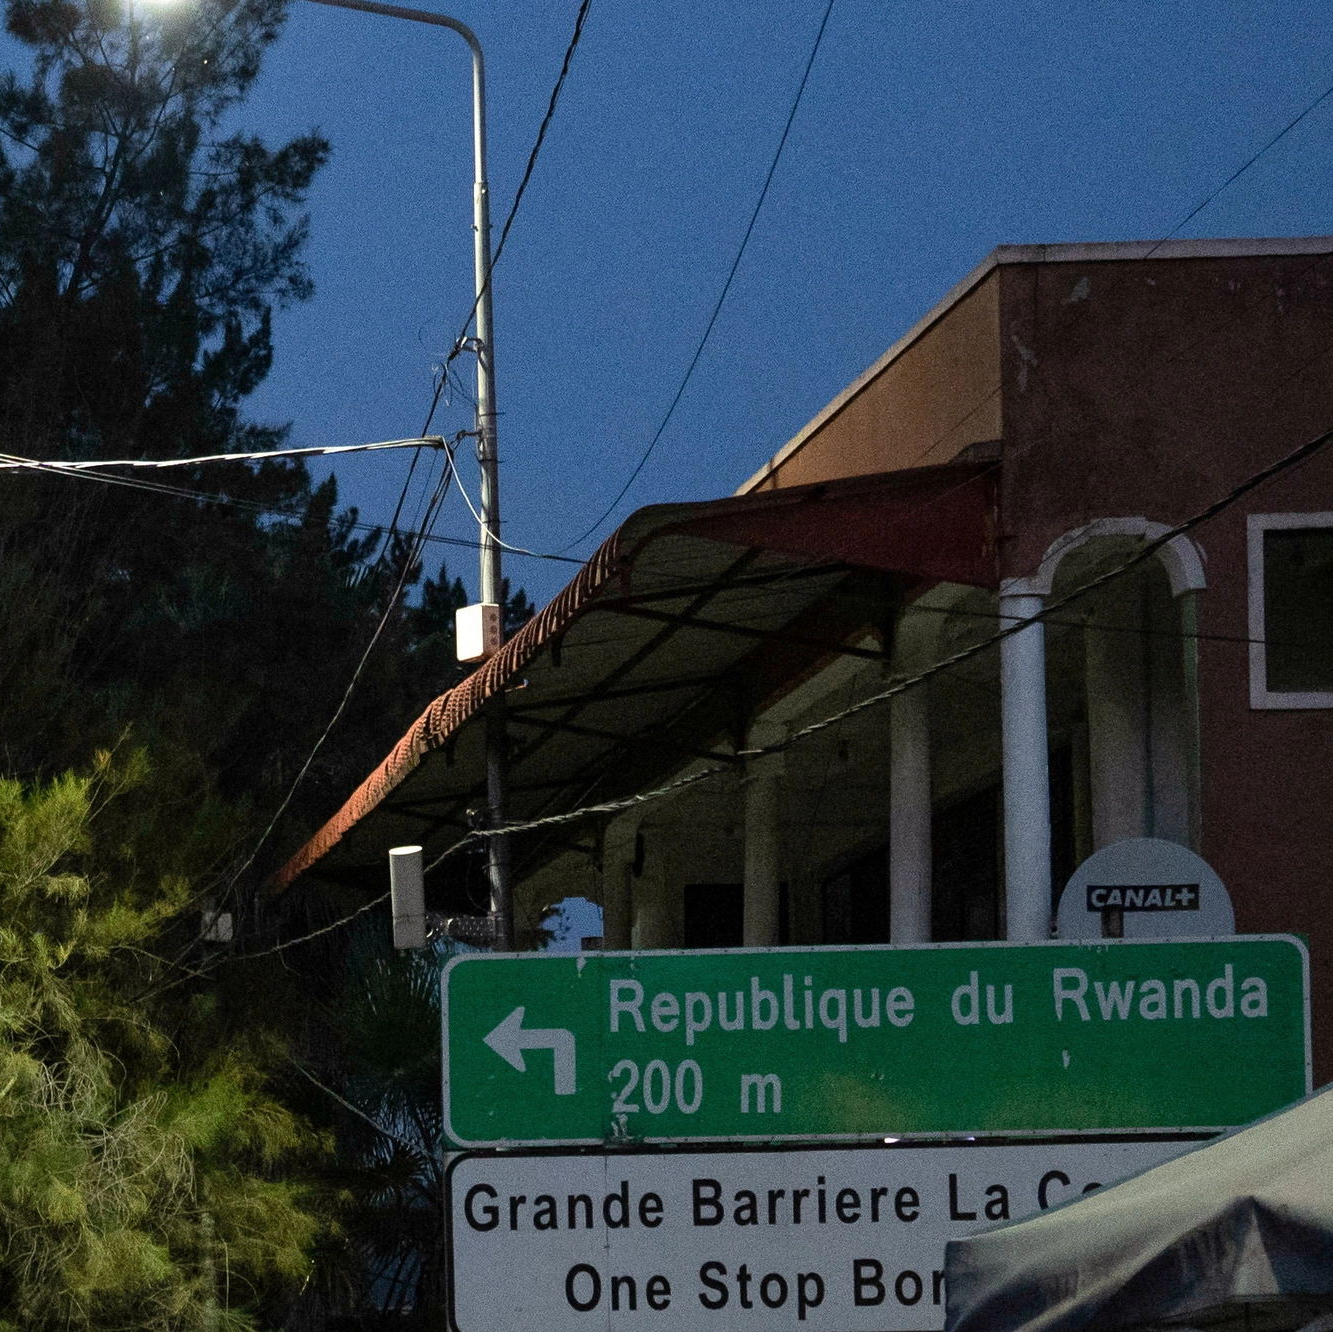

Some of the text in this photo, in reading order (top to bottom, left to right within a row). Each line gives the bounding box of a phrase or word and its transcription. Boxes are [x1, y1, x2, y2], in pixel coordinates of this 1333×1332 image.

[1090, 887, 1195, 908] CANAL+
[610, 965, 1268, 1043] Republique du Rwanda
[611, 1060, 782, 1114] 200 m
[464, 1170, 1103, 1232] Grande Barriere La C
[565, 1263, 671, 1312] One
[699, 1260, 825, 1321] Stop
